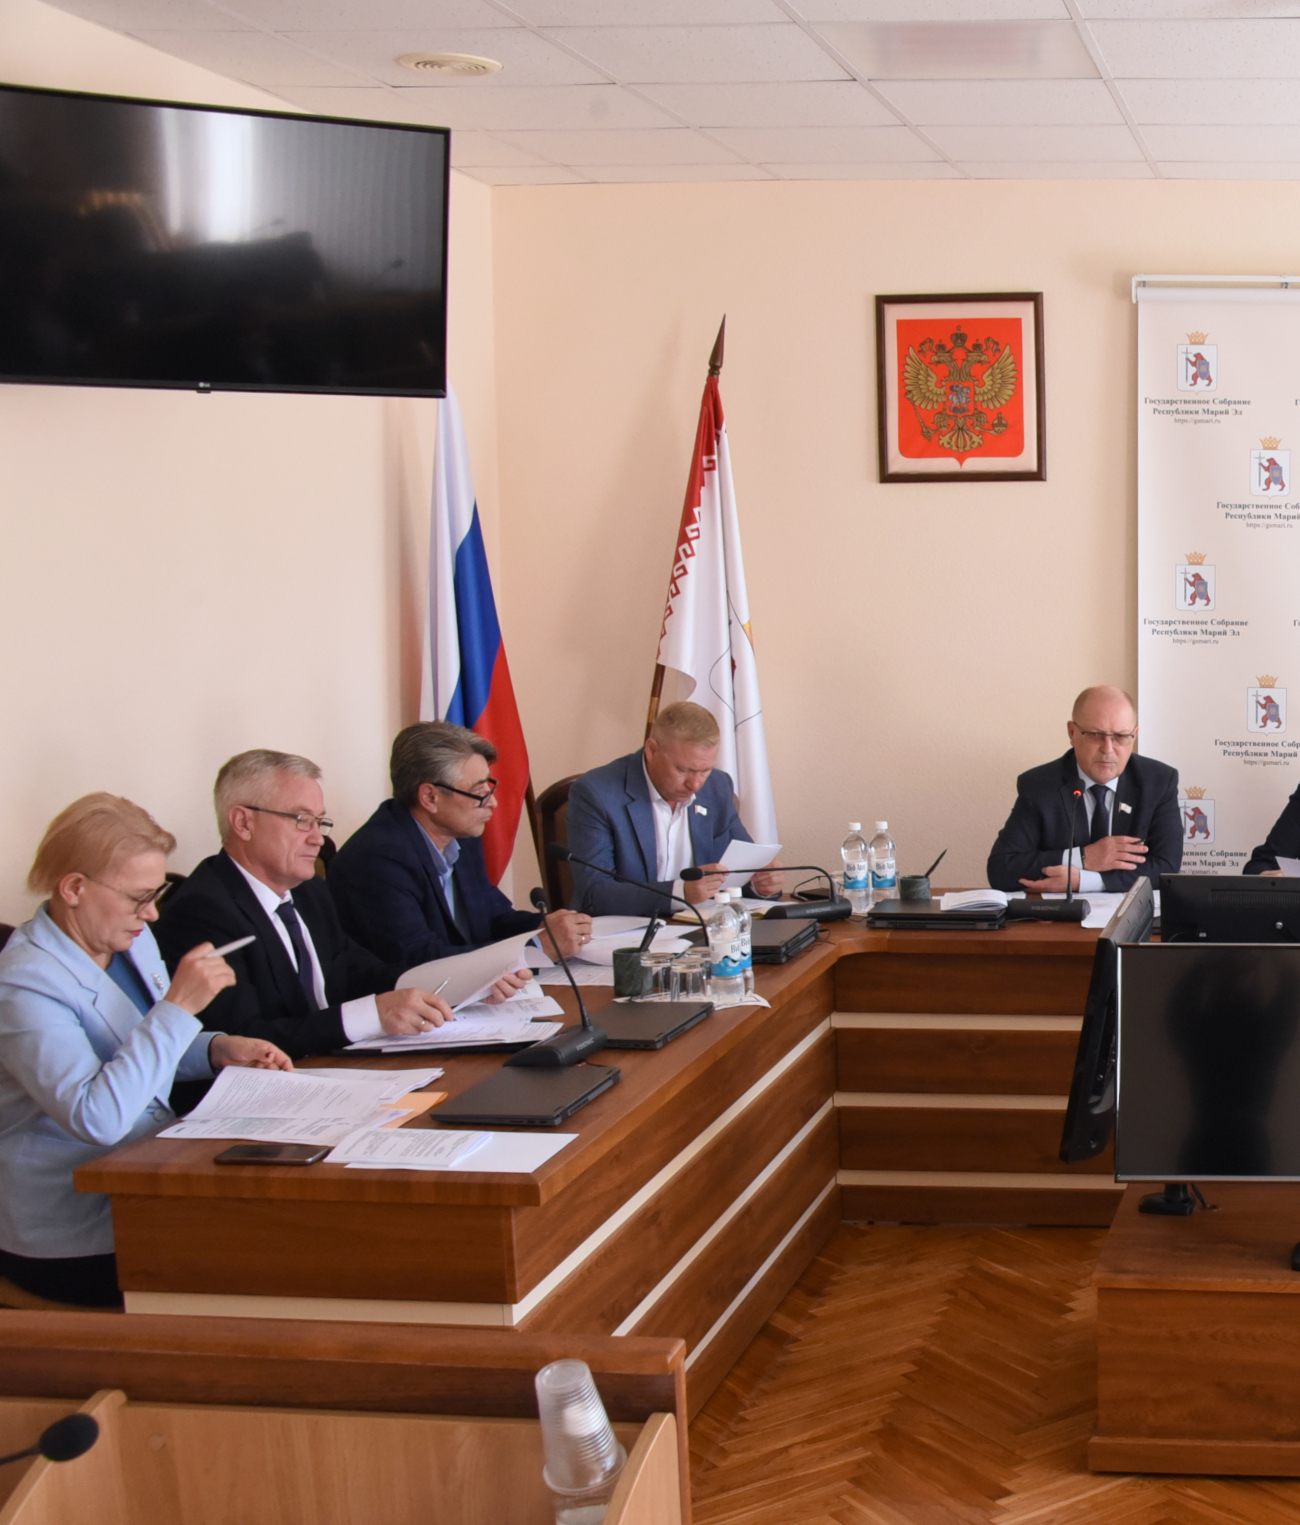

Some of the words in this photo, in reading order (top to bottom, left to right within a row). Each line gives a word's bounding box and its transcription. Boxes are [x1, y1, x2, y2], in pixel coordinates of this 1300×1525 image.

[1145, 397, 1210, 406] Государственное
[1212, 398, 1251, 406] Собрание
[1153, 408, 1199, 417] Республики
[1202, 408, 1229, 417] Марий
[1217, 502, 1282, 510] Государственное
[1225, 512, 1271, 521] Республики
[1274, 513, 1300, 521] Марий
[1144, 618, 1208, 626] Государственное
[1210, 619, 1248, 627] Собрание
[1152, 628, 1197, 637] Республики
[1200, 629, 1226, 637] Марий
[1215, 740, 1279, 749] Государственное
[1223, 750, 1268, 759] Республики
[1271, 750, 1297, 759] Марий
[1209, 850, 1248, 858] Собрание
[1200, 860, 1226, 868] Марий
